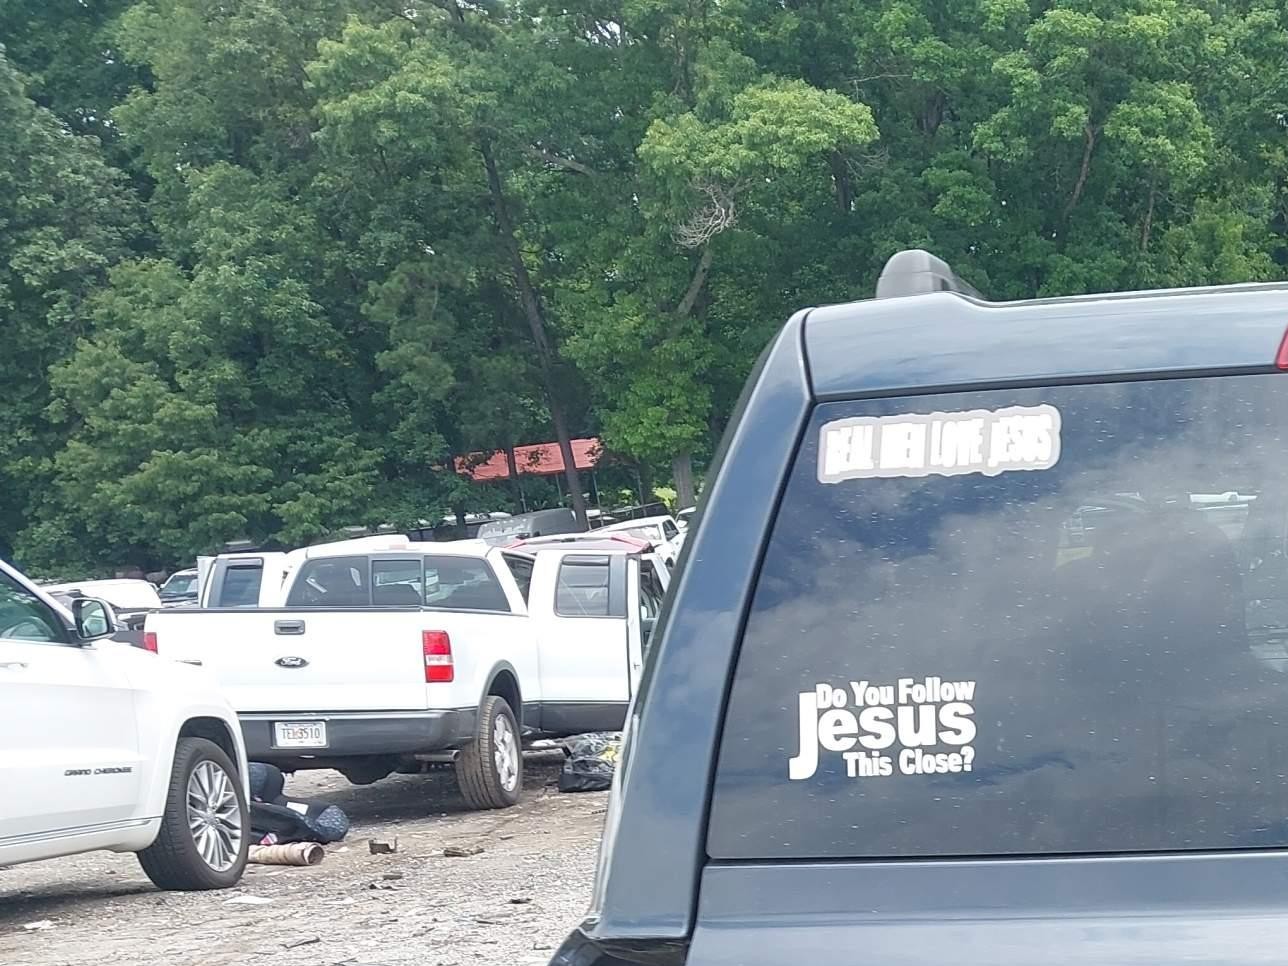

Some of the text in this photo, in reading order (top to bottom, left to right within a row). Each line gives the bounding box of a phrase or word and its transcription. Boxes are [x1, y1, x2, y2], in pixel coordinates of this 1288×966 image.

[815, 677, 976, 709] Do You Follow
[789, 691, 977, 780] Jesus
[842, 745, 976, 777] This Close?
